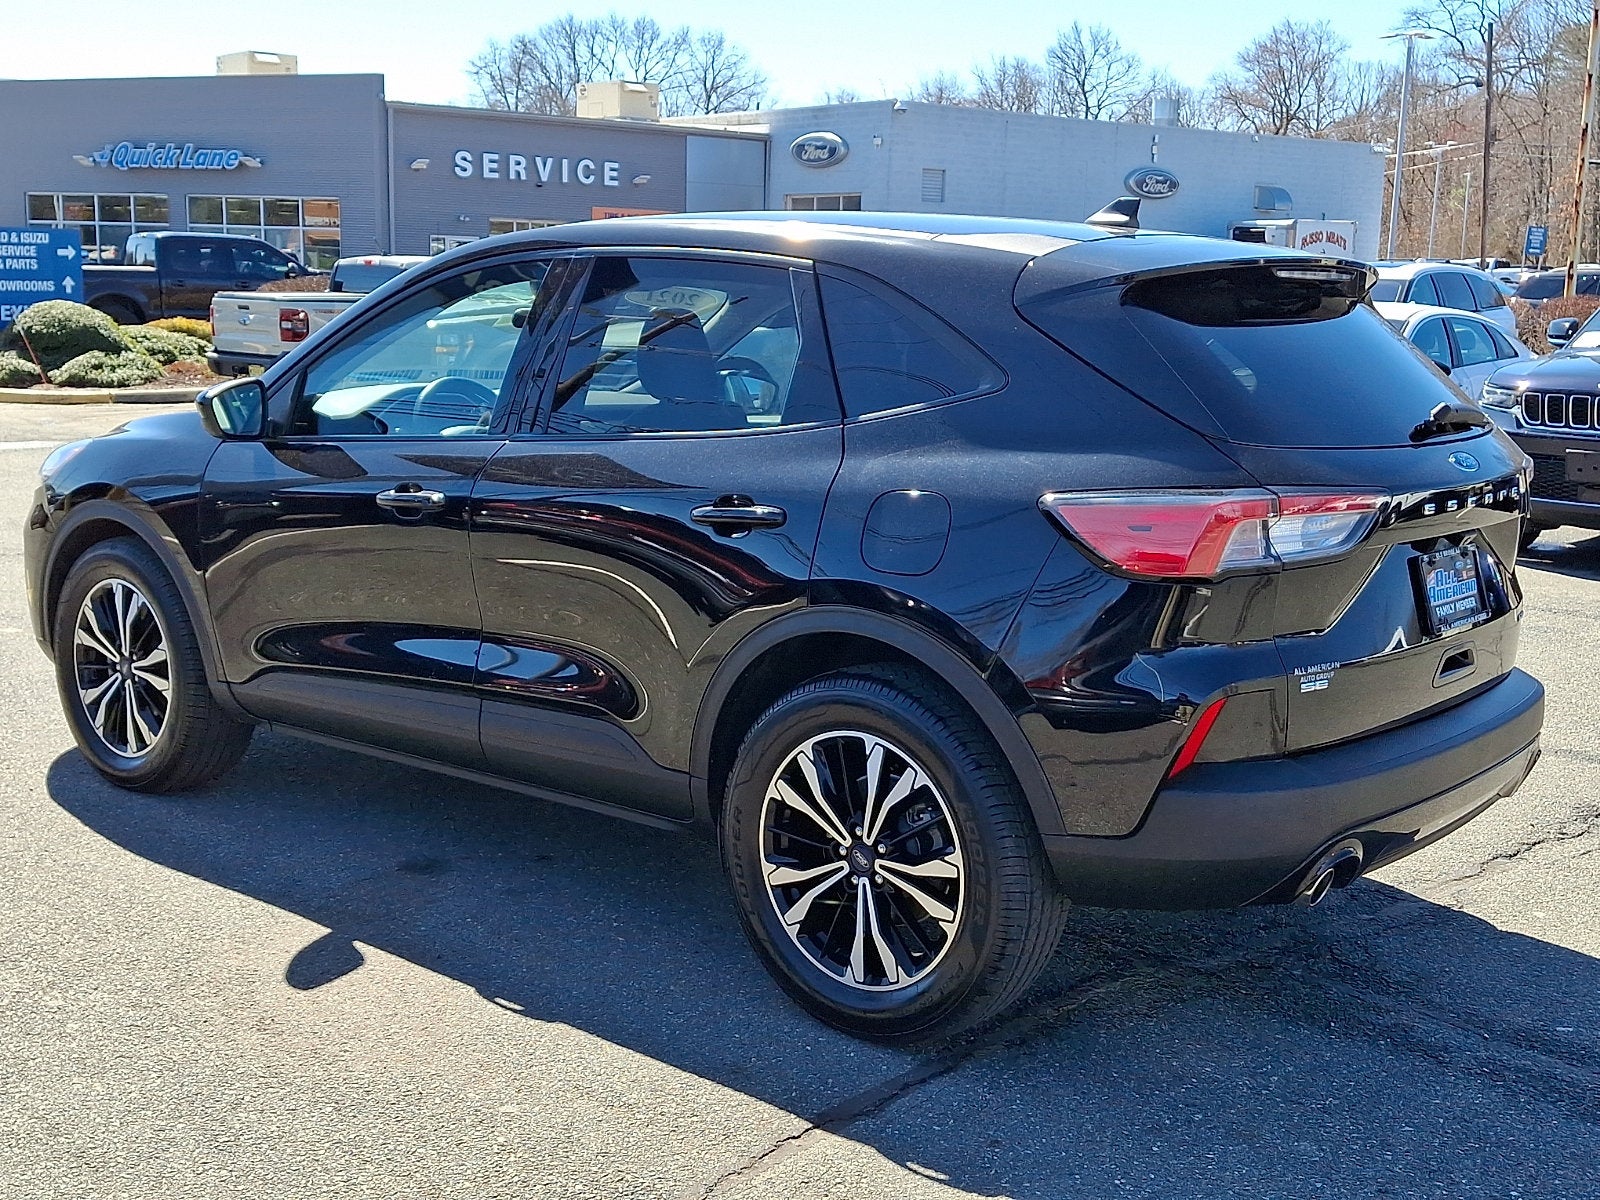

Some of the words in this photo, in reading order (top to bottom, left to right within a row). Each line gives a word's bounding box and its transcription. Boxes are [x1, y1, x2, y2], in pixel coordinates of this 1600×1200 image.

[112, 141, 181, 170] Quick
[178, 143, 240, 170] Lane
[454, 150, 620, 186] SERVICE
[1142, 174, 1171, 193] Ford
[10, 231, 19, 243] &
[20, 232, 49, 244] ISUZU
[0, 245, 37, 257] ERVICE
[6, 258, 38, 270] PARTS
[1422, 486, 1520, 516] ESCAPE
[1435, 568, 1457, 588] ALL
[1427, 578, 1477, 604] AMERICAN
[1294, 667, 1306, 676] ALL
[1307, 661, 1340, 674] AMERICAN
[1300, 675, 1315, 683] AUTO
[1316, 671, 1334, 680] GROUP
[1300, 680, 1329, 693] SE
